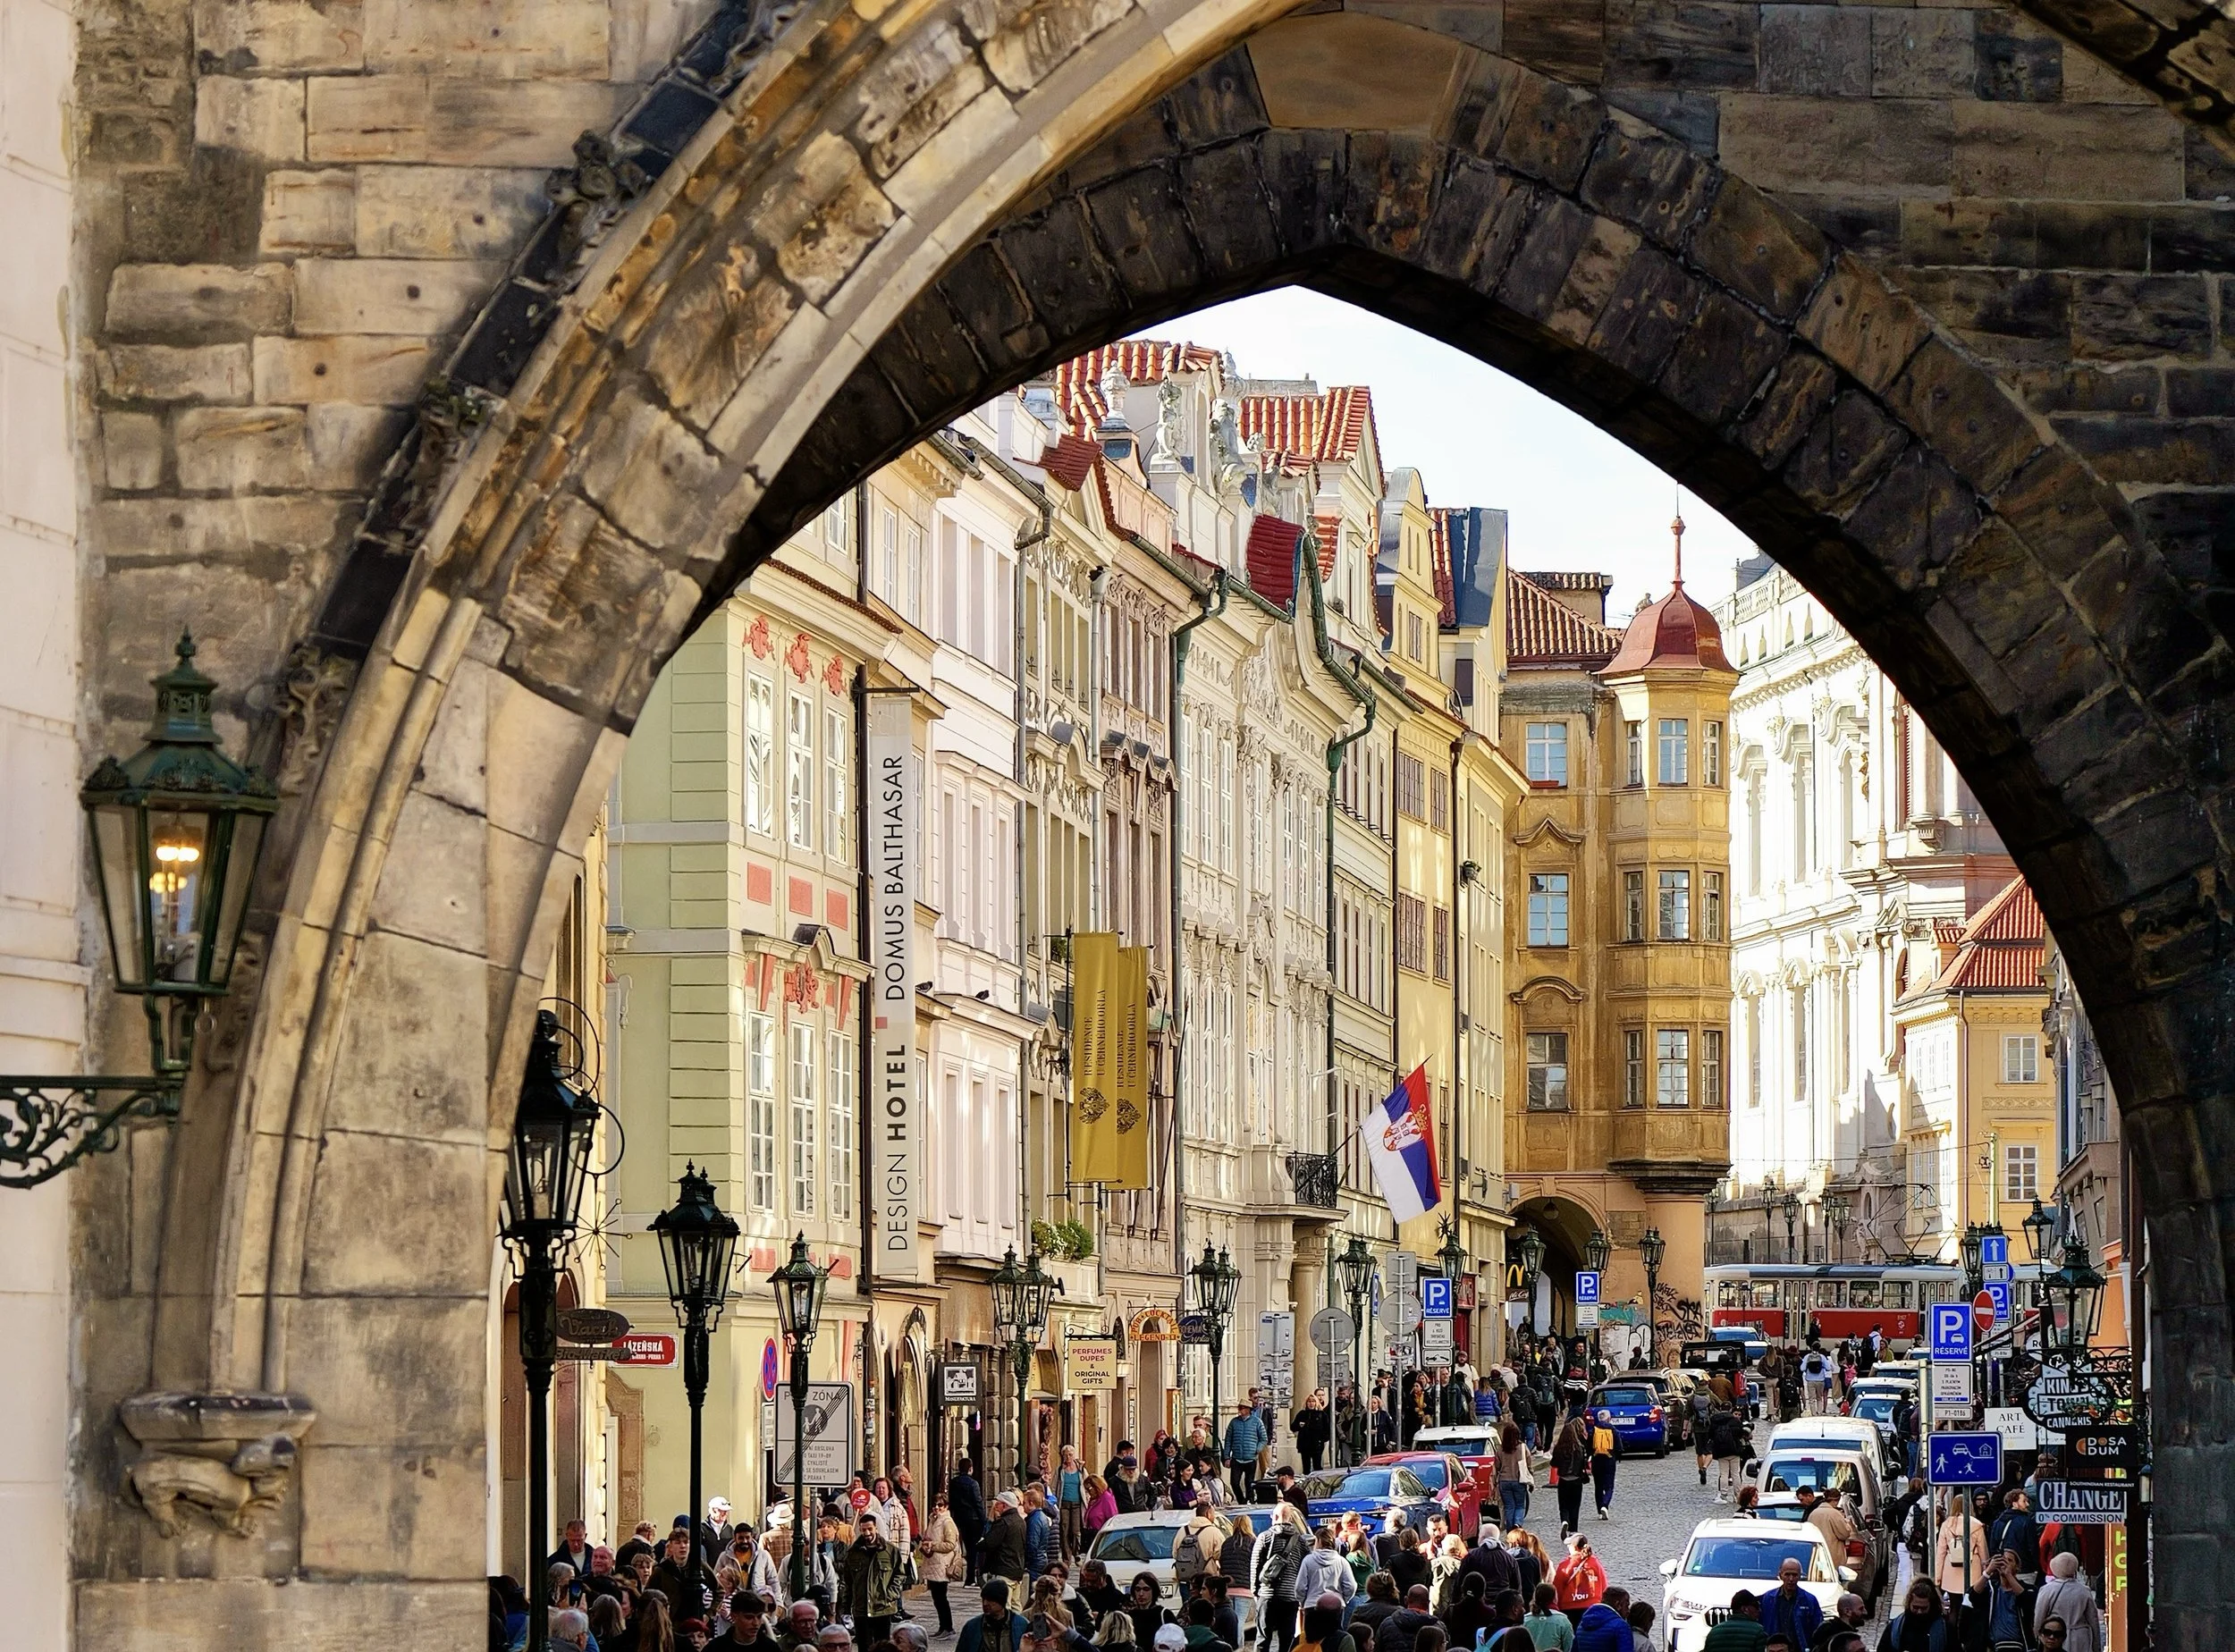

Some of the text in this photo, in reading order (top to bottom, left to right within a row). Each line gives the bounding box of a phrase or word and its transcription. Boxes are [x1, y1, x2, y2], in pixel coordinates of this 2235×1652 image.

[883, 755, 905, 1000] DOMUS BALTHASAR
[1097, 990, 1105, 1016] ORLA
[1127, 1003, 1135, 1030] ORLA
[1084, 1017, 1092, 1075] RESIDENCE
[886, 1044, 907, 1250] DESIGN HOTEL
[1430, 1283, 1446, 1306] P
[1581, 1276, 1594, 1294] P
[1131, 1310, 1177, 1332] PUB COCKTAIL
[1939, 1311, 1963, 1344] P
[1935, 1346, 1968, 1354] RÉSERVÉ
[1996, 1422, 2025, 1434] CAFÉ
[1999, 1413, 2021, 1421] ART
[2087, 1447, 2119, 1455] DUM
[2088, 1437, 2127, 1446] DOSA
[2039, 1481, 2121, 1511] CHANGE
[2053, 1513, 2122, 1522] COMMISSION
